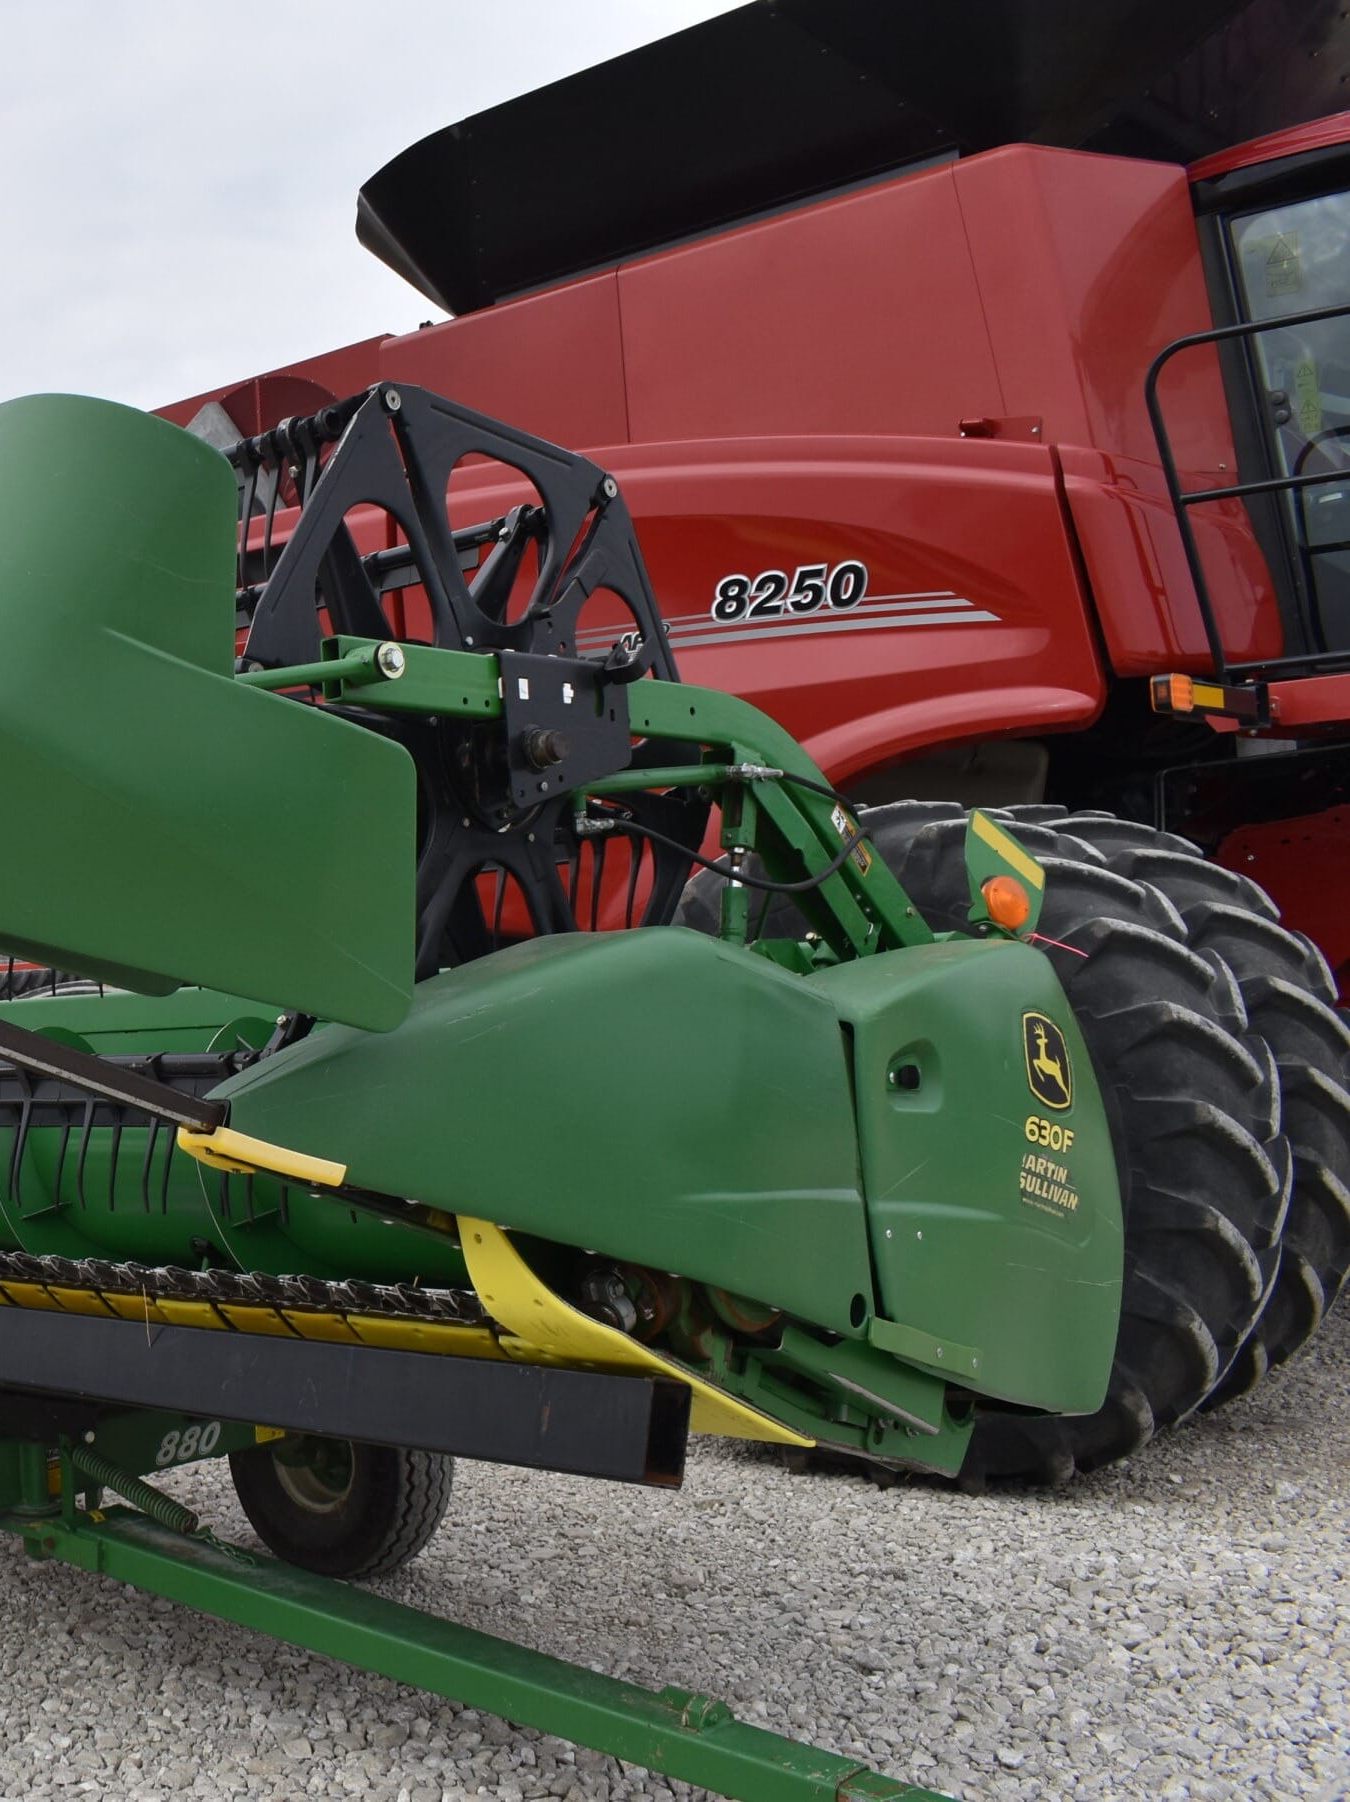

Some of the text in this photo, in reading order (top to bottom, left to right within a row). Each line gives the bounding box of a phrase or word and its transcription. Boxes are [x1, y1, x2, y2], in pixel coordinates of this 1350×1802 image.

[711, 560, 868, 623] 8250
[1025, 1115, 1074, 1153] 630F
[156, 1421, 221, 1466] 880
